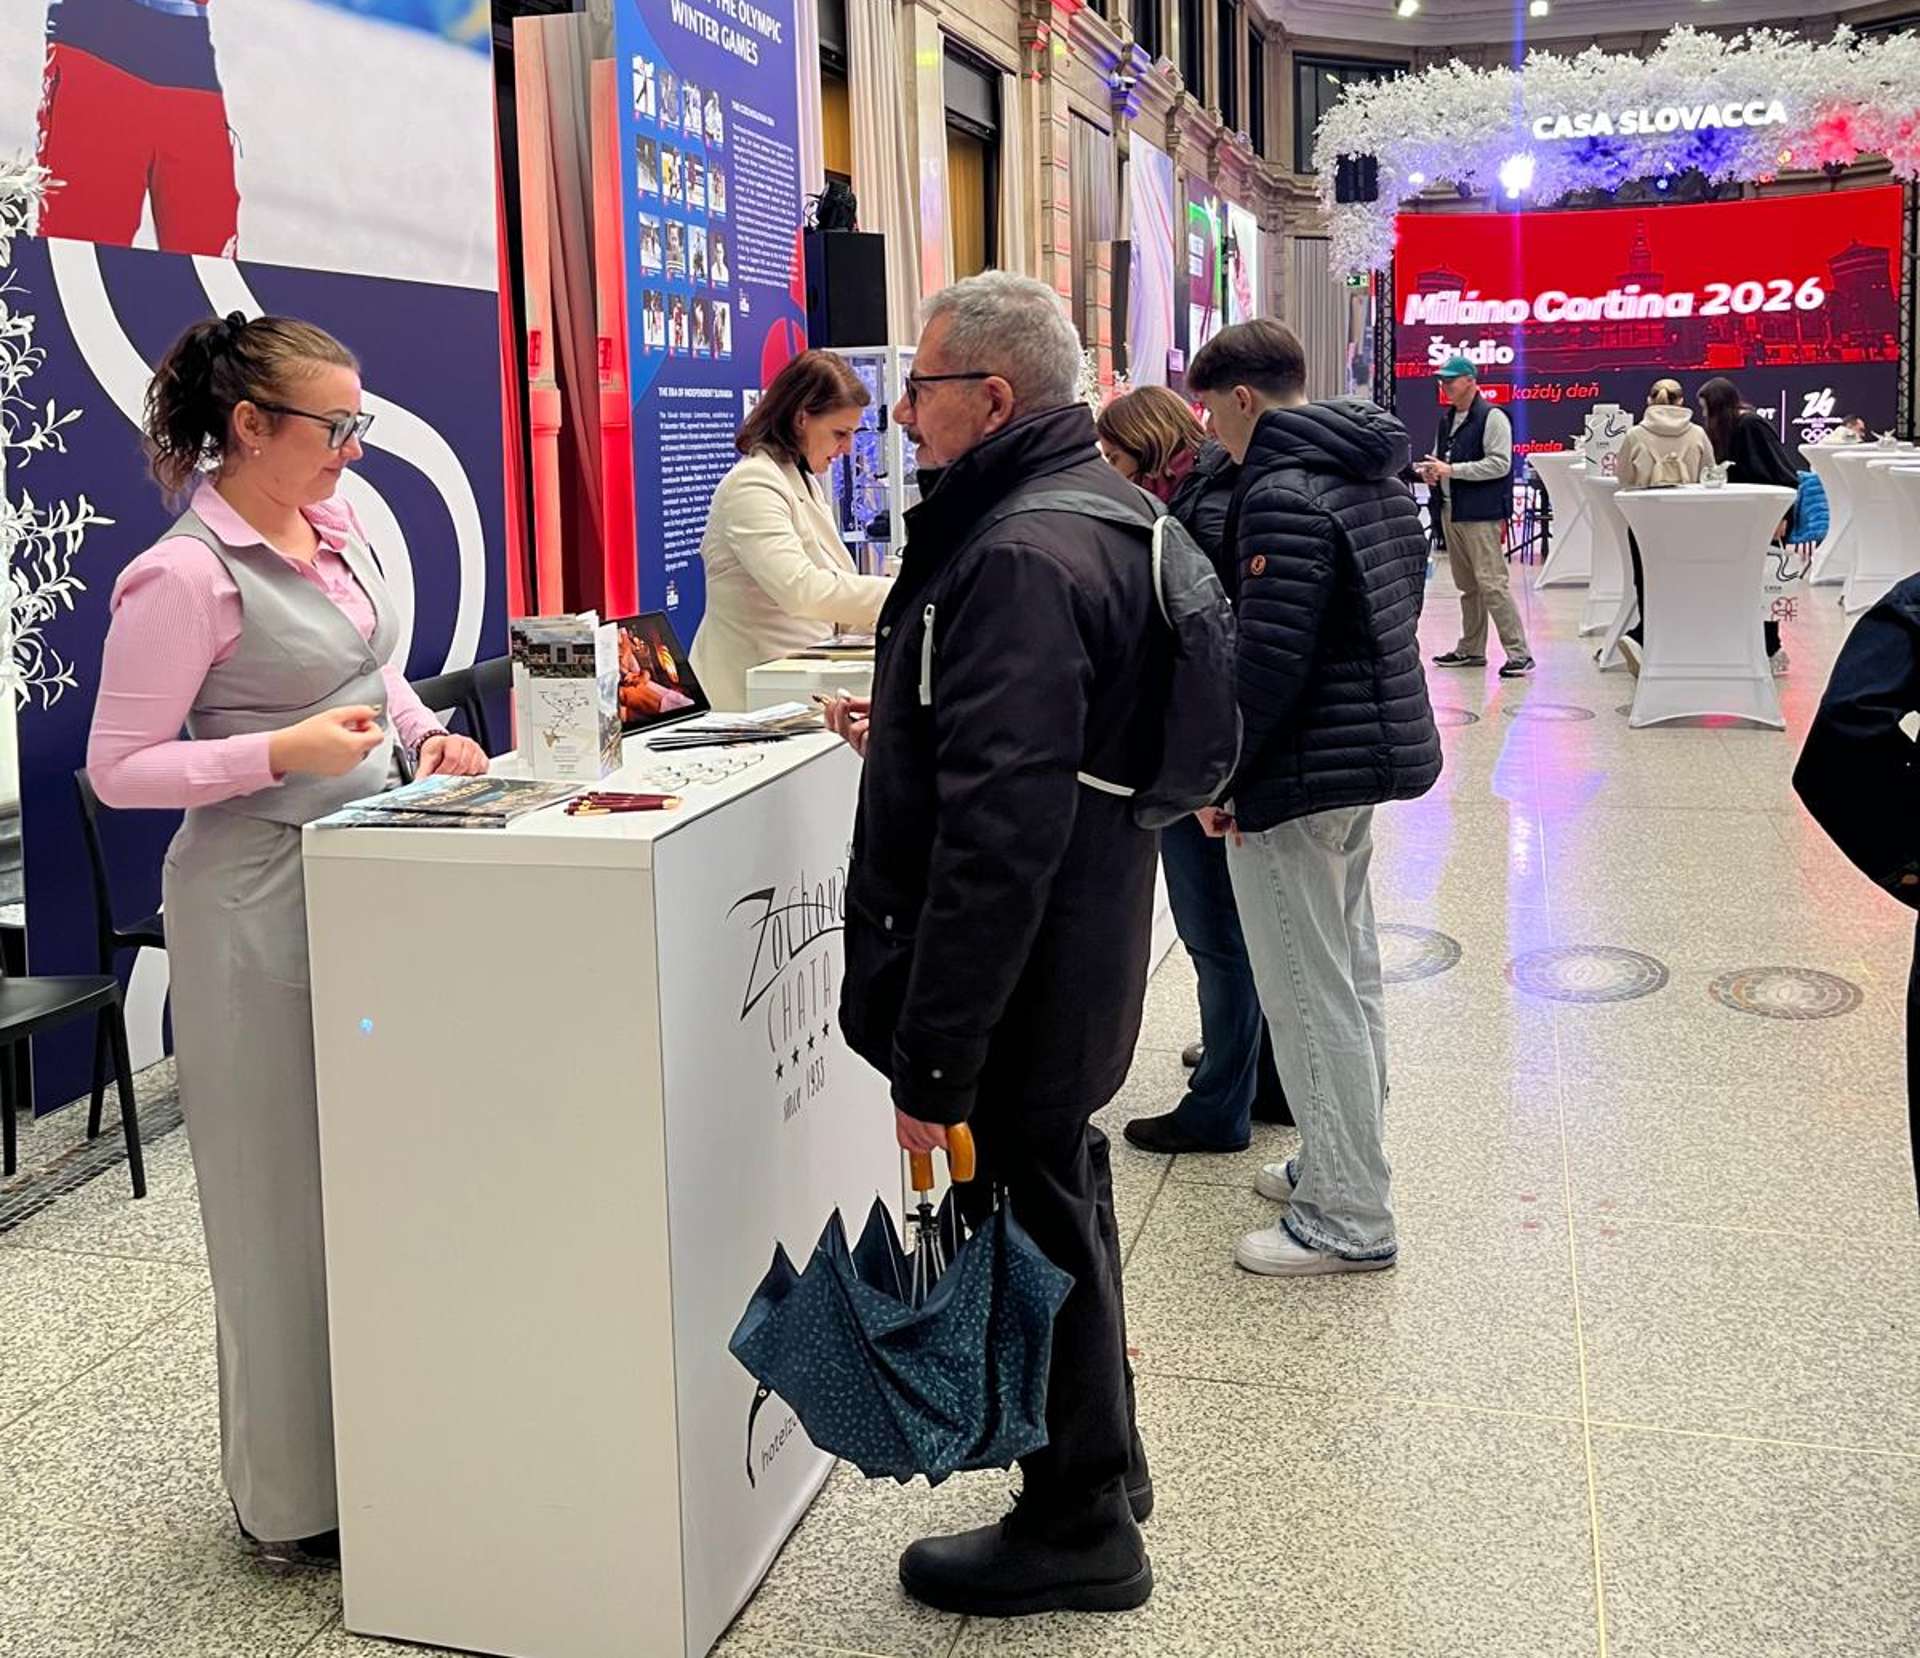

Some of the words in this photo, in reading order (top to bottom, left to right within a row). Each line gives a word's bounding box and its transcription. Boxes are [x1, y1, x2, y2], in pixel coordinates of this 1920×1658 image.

[670, 0, 721, 46] WINTER
[721, 25, 759, 67] GAMES
[737, 0, 783, 44] OLYMPIC
[1532, 113, 1614, 140] CASA
[1619, 100, 1788, 136] SLOVACCA
[1403, 290, 1529, 325] Miláno
[1533, 284, 1695, 323] Cortina
[1699, 276, 1826, 317] 2026
[1511, 382, 1562, 403] každý
[1565, 381, 1600, 398] deň
